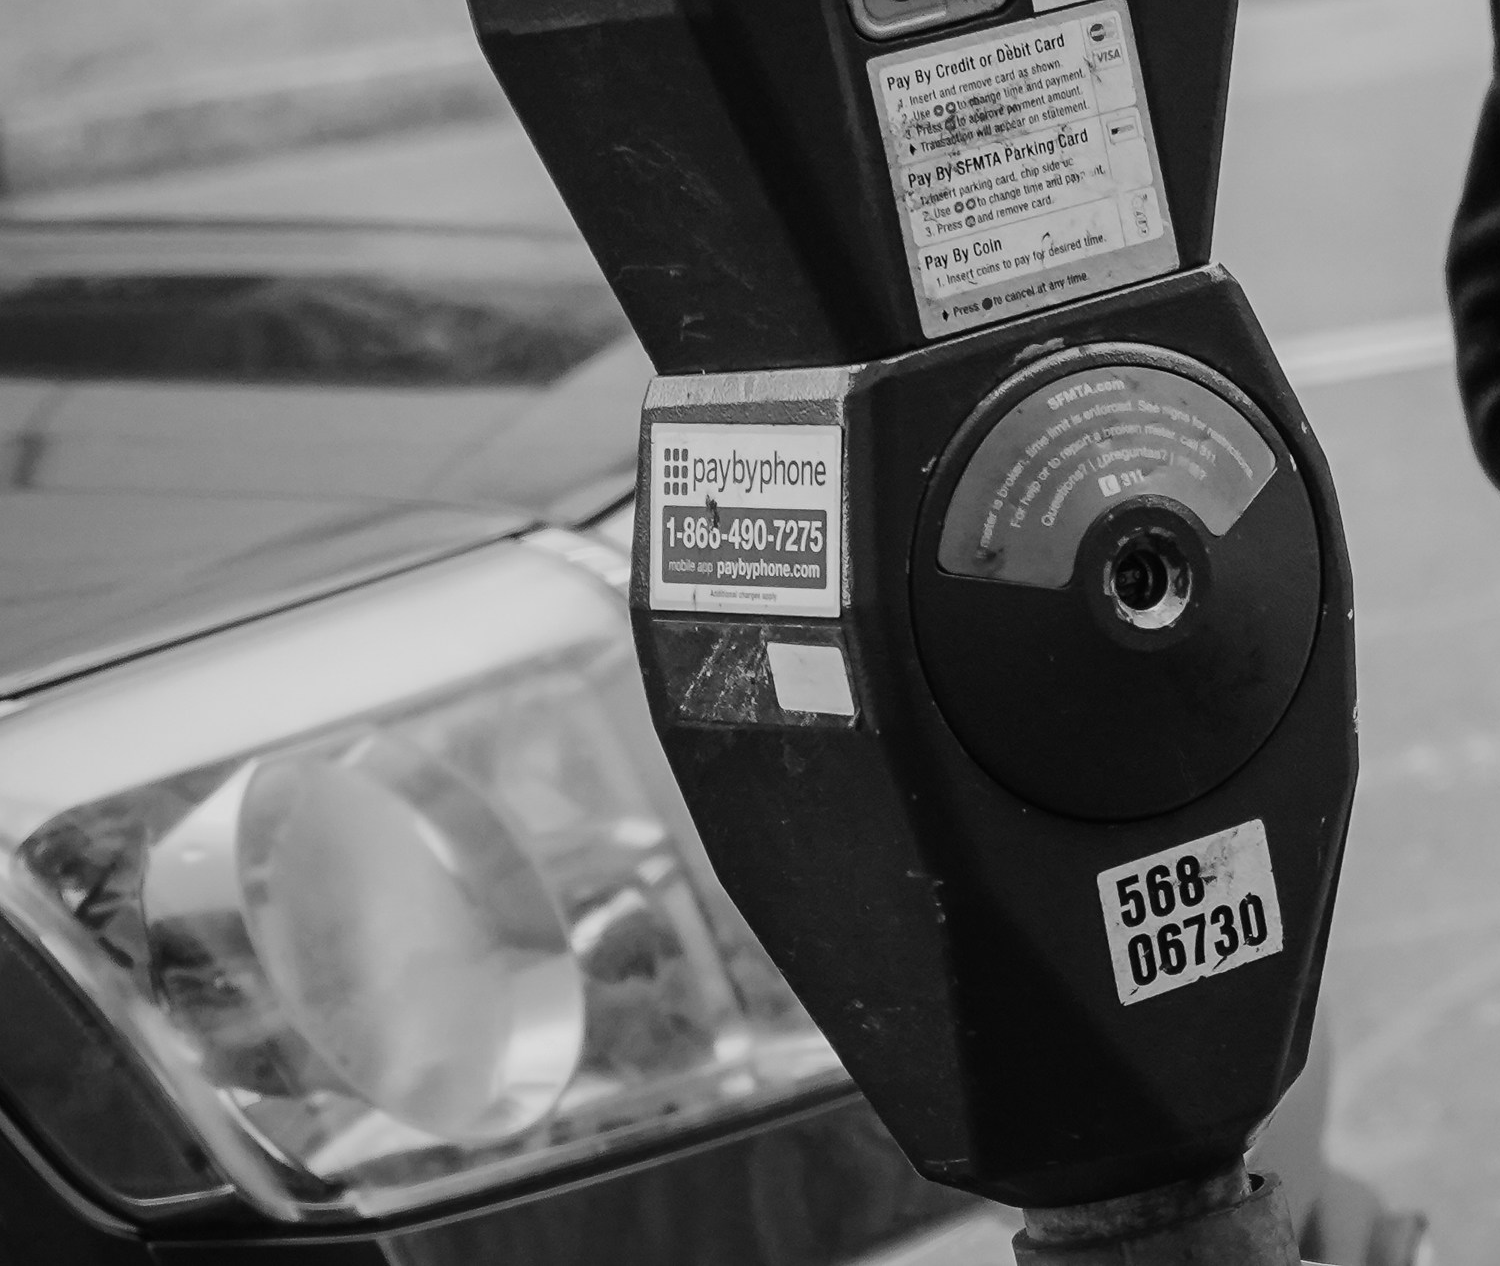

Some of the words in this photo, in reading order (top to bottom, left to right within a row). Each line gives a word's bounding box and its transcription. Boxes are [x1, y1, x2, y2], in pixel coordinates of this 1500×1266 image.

[886, 75, 910, 90] Pay
[914, 69, 931, 85] By
[935, 56, 976, 78] Credit
[979, 54, 991, 67] or
[996, 42, 1031, 63] Debit
[1034, 33, 1065, 53] Card
[1096, 48, 1121, 63] VISA
[909, 90, 937, 105] Insert
[939, 84, 957, 98] and
[958, 77, 992, 92] remove
[994, 69, 1015, 84] card
[1018, 68, 1028, 78] as
[1031, 60, 1061, 74] shown.
[912, 109, 930, 121] Use
[956, 100, 968, 110] to
[968, 91, 1001, 108] change
[1003, 85, 1023, 98] time
[1024, 78, 1043, 92] and
[1045, 68, 1083, 88] payment.
[915, 122, 943, 136] Press
[955, 115, 966, 127] to
[968, 104, 1004, 124] approve
[1006, 95, 1045, 115] payment
[1047, 85, 1080, 103] amount.
[920, 131, 974, 151] Transaction
[976, 124, 992, 137] will
[994, 117, 1025, 135] appear
[1028, 114, 1040, 124] on
[1042, 99, 1087, 120] statement.
[907, 172, 931, 188] Pay
[935, 163, 952, 182] By
[955, 151, 1001, 175] SFMTA
[1004, 140, 1054, 162] Parking
[1057, 128, 1088, 148] Card
[928, 188, 956, 203] Insert
[959, 179, 993, 197] parking
[1020, 167, 1039, 179] chip
[1042, 160, 1060, 173] side
[933, 207, 951, 218] Use
[976, 197, 987, 207] to
[988, 188, 1021, 204] change
[1023, 182, 1043, 194] time
[1045, 175, 1063, 188] and
[925, 226, 935, 237] 3.
[936, 220, 963, 234] Press
[977, 209, 994, 223] and
[996, 202, 1028, 218] remove
[1031, 195, 1052, 209] card.
[924, 254, 948, 270] Pay
[952, 247, 968, 263] By
[972, 238, 1002, 256] Coin
[936, 277, 945, 287] 1.
[946, 268, 974, 284] Insert
[976, 263, 1000, 276] coins
[1002, 259, 1012, 269] to
[1014, 254, 1030, 268] pay
[1032, 250, 1045, 260] for
[1048, 238, 1082, 257] desired
[1083, 234, 1106, 246] time.
[952, 302, 980, 317] Press
[992, 295, 1003, 305] to
[1004, 286, 1035, 302] cancel
[1037, 283, 1047, 294] at
[1048, 279, 1065, 291] any
[1047, 380, 1125, 411] SFMTA.com
[693, 450, 826, 493] paybyphone
[1010, 507, 1027, 528] For
[1019, 481, 1041, 506] help
[1037, 467, 1050, 481] or
[1048, 457, 1061, 469] to
[1120, 468, 1145, 486] 311
[1041, 464, 1087, 526] Questions?
[666, 516, 823, 552] 1-866-490-7275
[668, 559, 695, 573] mobile
[697, 561, 713, 573] app
[716, 558, 820, 579] paybyphone.com
[1127, 894, 1268, 986] 06730
